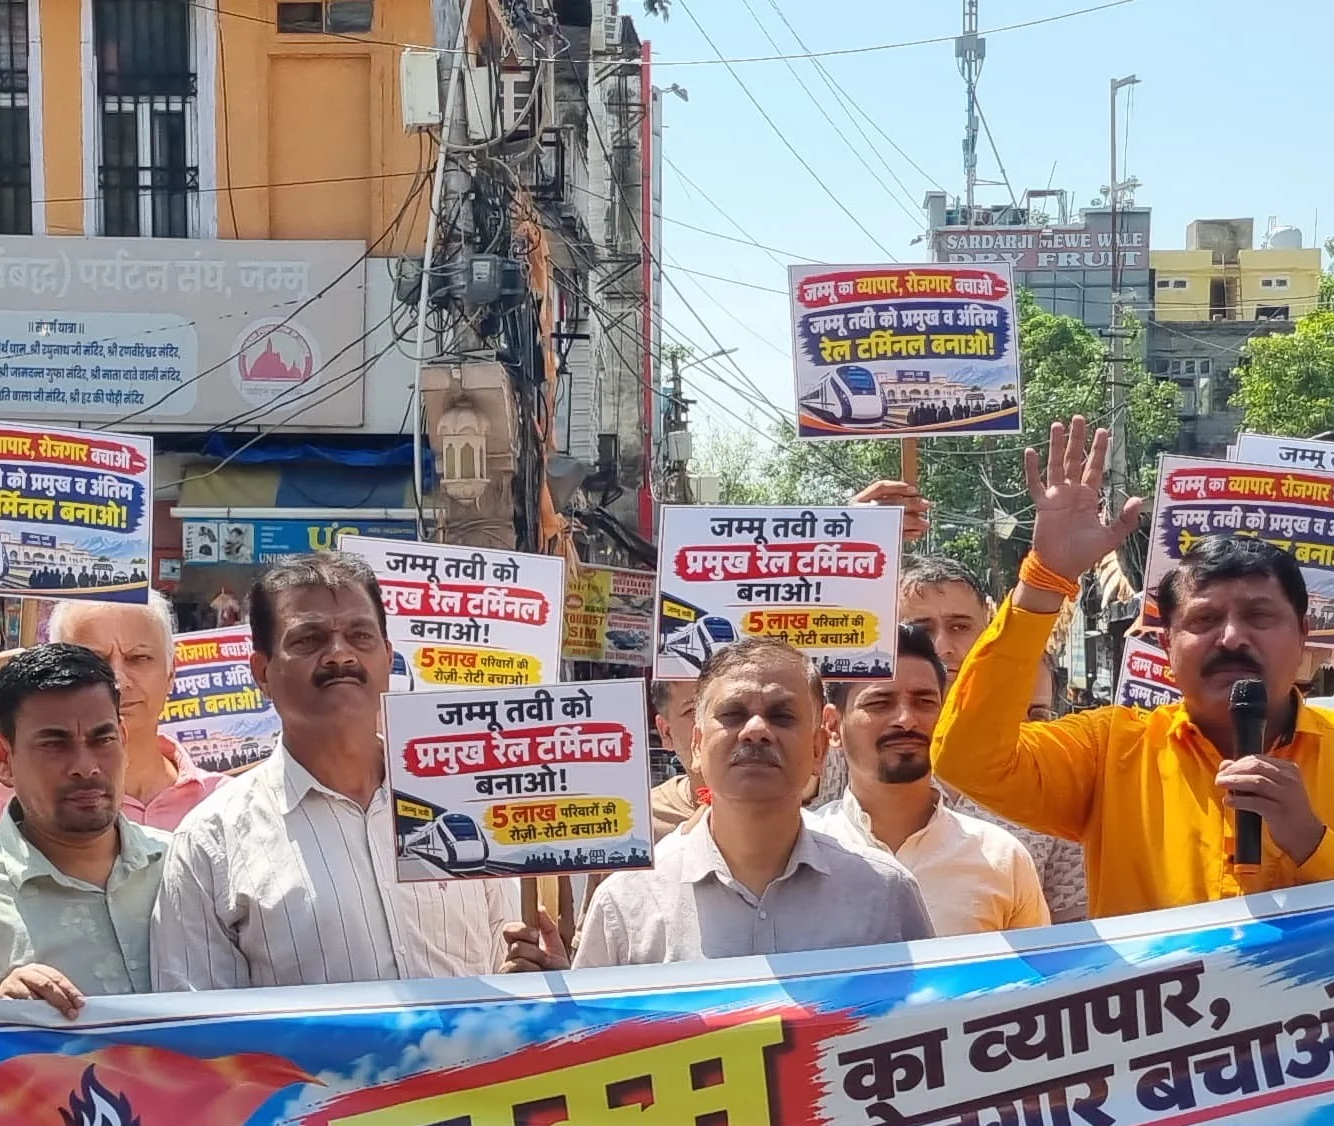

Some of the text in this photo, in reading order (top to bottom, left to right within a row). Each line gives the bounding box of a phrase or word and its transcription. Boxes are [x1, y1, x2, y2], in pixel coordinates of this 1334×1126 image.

[946, 232, 1143, 249] SARDARJI MEWE WALE
[1037, 251, 1142, 267] FRUIT
[570, 626, 597, 639] SIM
[436, 688, 593, 732] जम्मू तवी को
[414, 726, 623, 774] प्रमुख रेल टर्मिनल
[474, 764, 568, 795] बनाओ!
[492, 801, 616, 828] 5 लाख परिवारों की
[509, 817, 619, 843] रोज़ी-रोटी बचाओ!
[840, 960, 1231, 1102] का व्यापार,
